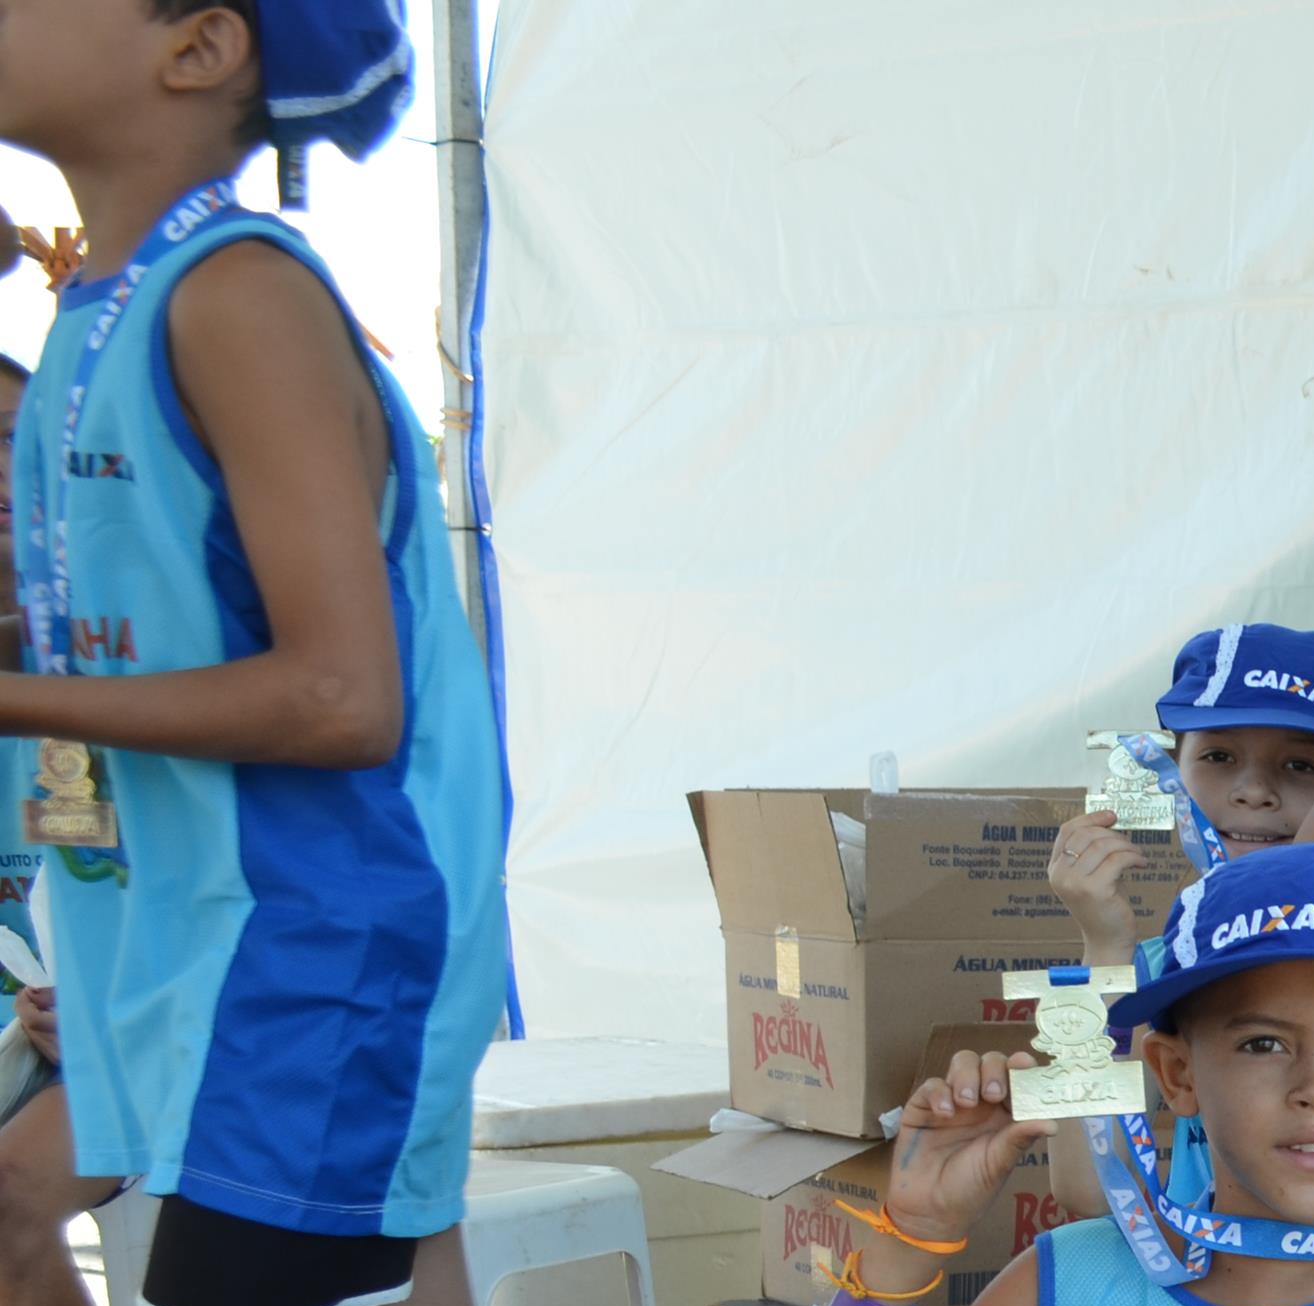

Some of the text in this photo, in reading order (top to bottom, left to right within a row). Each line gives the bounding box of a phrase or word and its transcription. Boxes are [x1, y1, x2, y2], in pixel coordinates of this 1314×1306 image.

[88, 263, 147, 350] CAIXA
[982, 823, 1016, 842] ÁGUA
[1022, 827, 1060, 842] MINER
[0, 855, 31, 868] UITO
[954, 955, 1083, 972] ÁGUA MINERA
[804, 983, 849, 1001] NATURAL
[752, 1011, 834, 1090] REGINA
[838, 1181, 878, 1201] NATURAL
[1158, 1194, 1243, 1247] CAIXA
